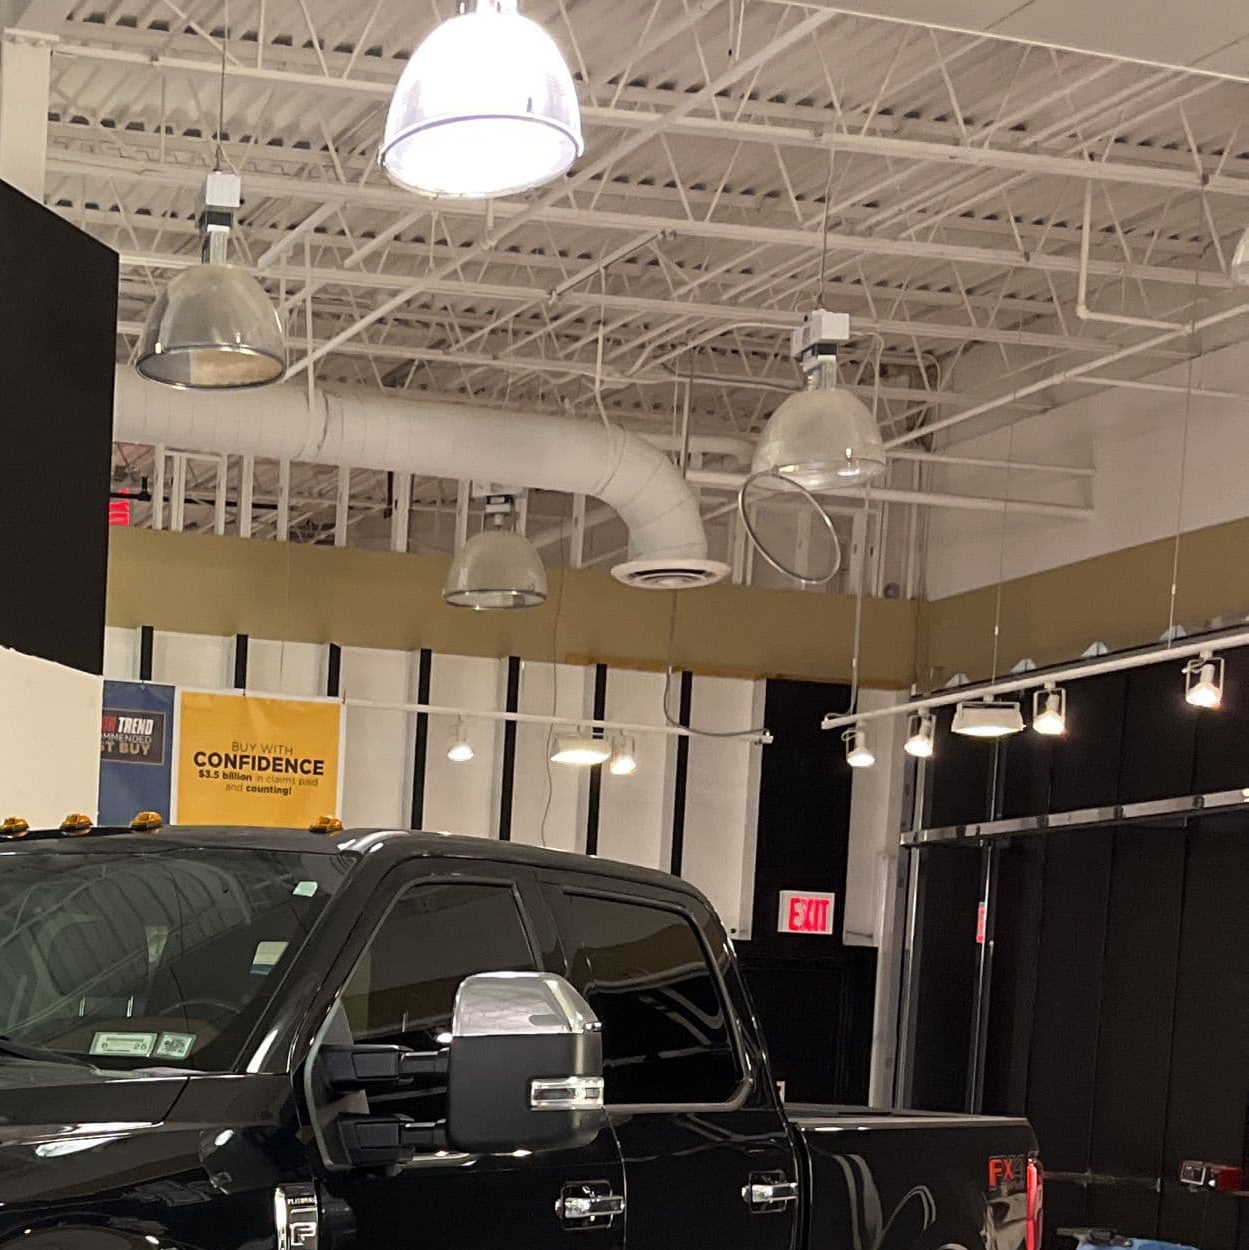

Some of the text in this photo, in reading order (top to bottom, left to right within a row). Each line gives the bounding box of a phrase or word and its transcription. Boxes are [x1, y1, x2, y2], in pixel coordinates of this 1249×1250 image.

[117, 716, 154, 736] TREND
[119, 743, 151, 755] BUY
[231, 741, 294, 756] BUY WITH
[193, 751, 325, 776] CONFIDENCE
[198, 769, 319, 788] $3.5 billion in claims paid
[225, 782, 293, 797] and counting!
[789, 897, 830, 932] EXIT
[989, 1155, 1025, 1190] FX4
